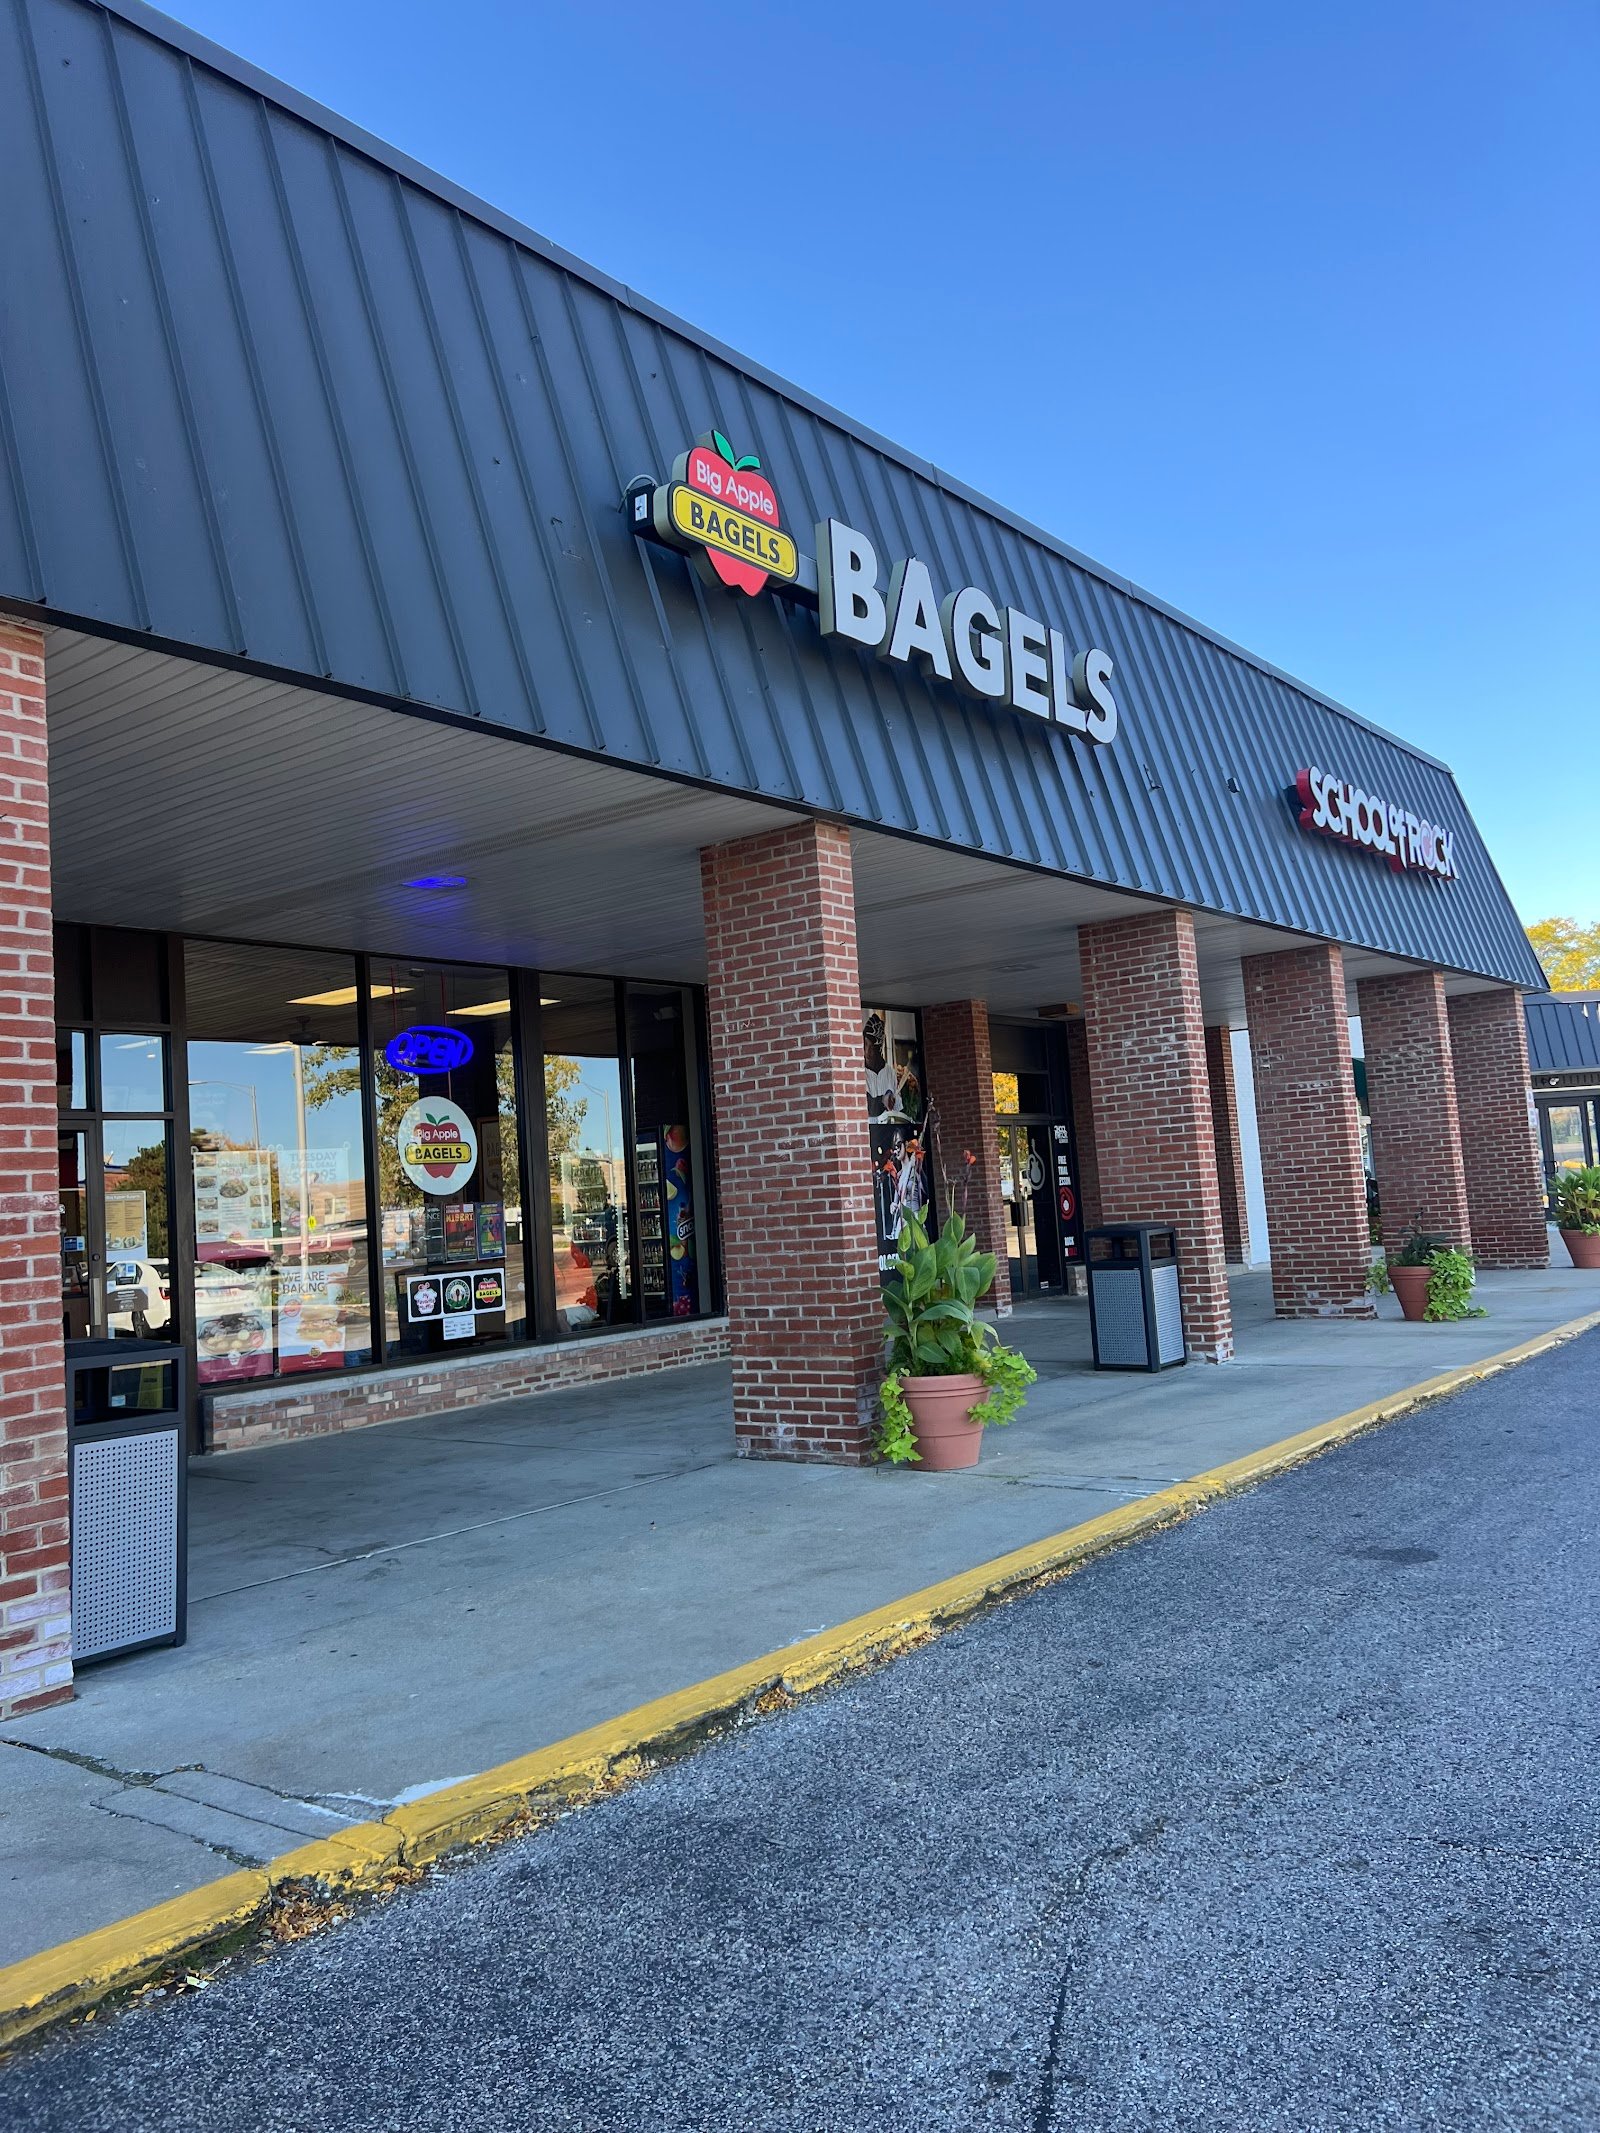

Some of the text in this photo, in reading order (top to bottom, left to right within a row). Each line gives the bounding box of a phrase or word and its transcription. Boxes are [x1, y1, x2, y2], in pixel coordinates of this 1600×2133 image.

[696, 458, 774, 517] Big Apple
[690, 500, 781, 566] BAGELS
[822, 517, 1119, 746] BAGELS
[1305, 765, 1460, 880] SCHOOL of ROCK
[394, 1032, 465, 1069] OPEN
[415, 1147, 463, 1160] BAGELS
[416, 1128, 459, 1142] Big Apple
[282, 1270, 325, 1283] WE ARE
[282, 1282, 325, 1295] BAKING
